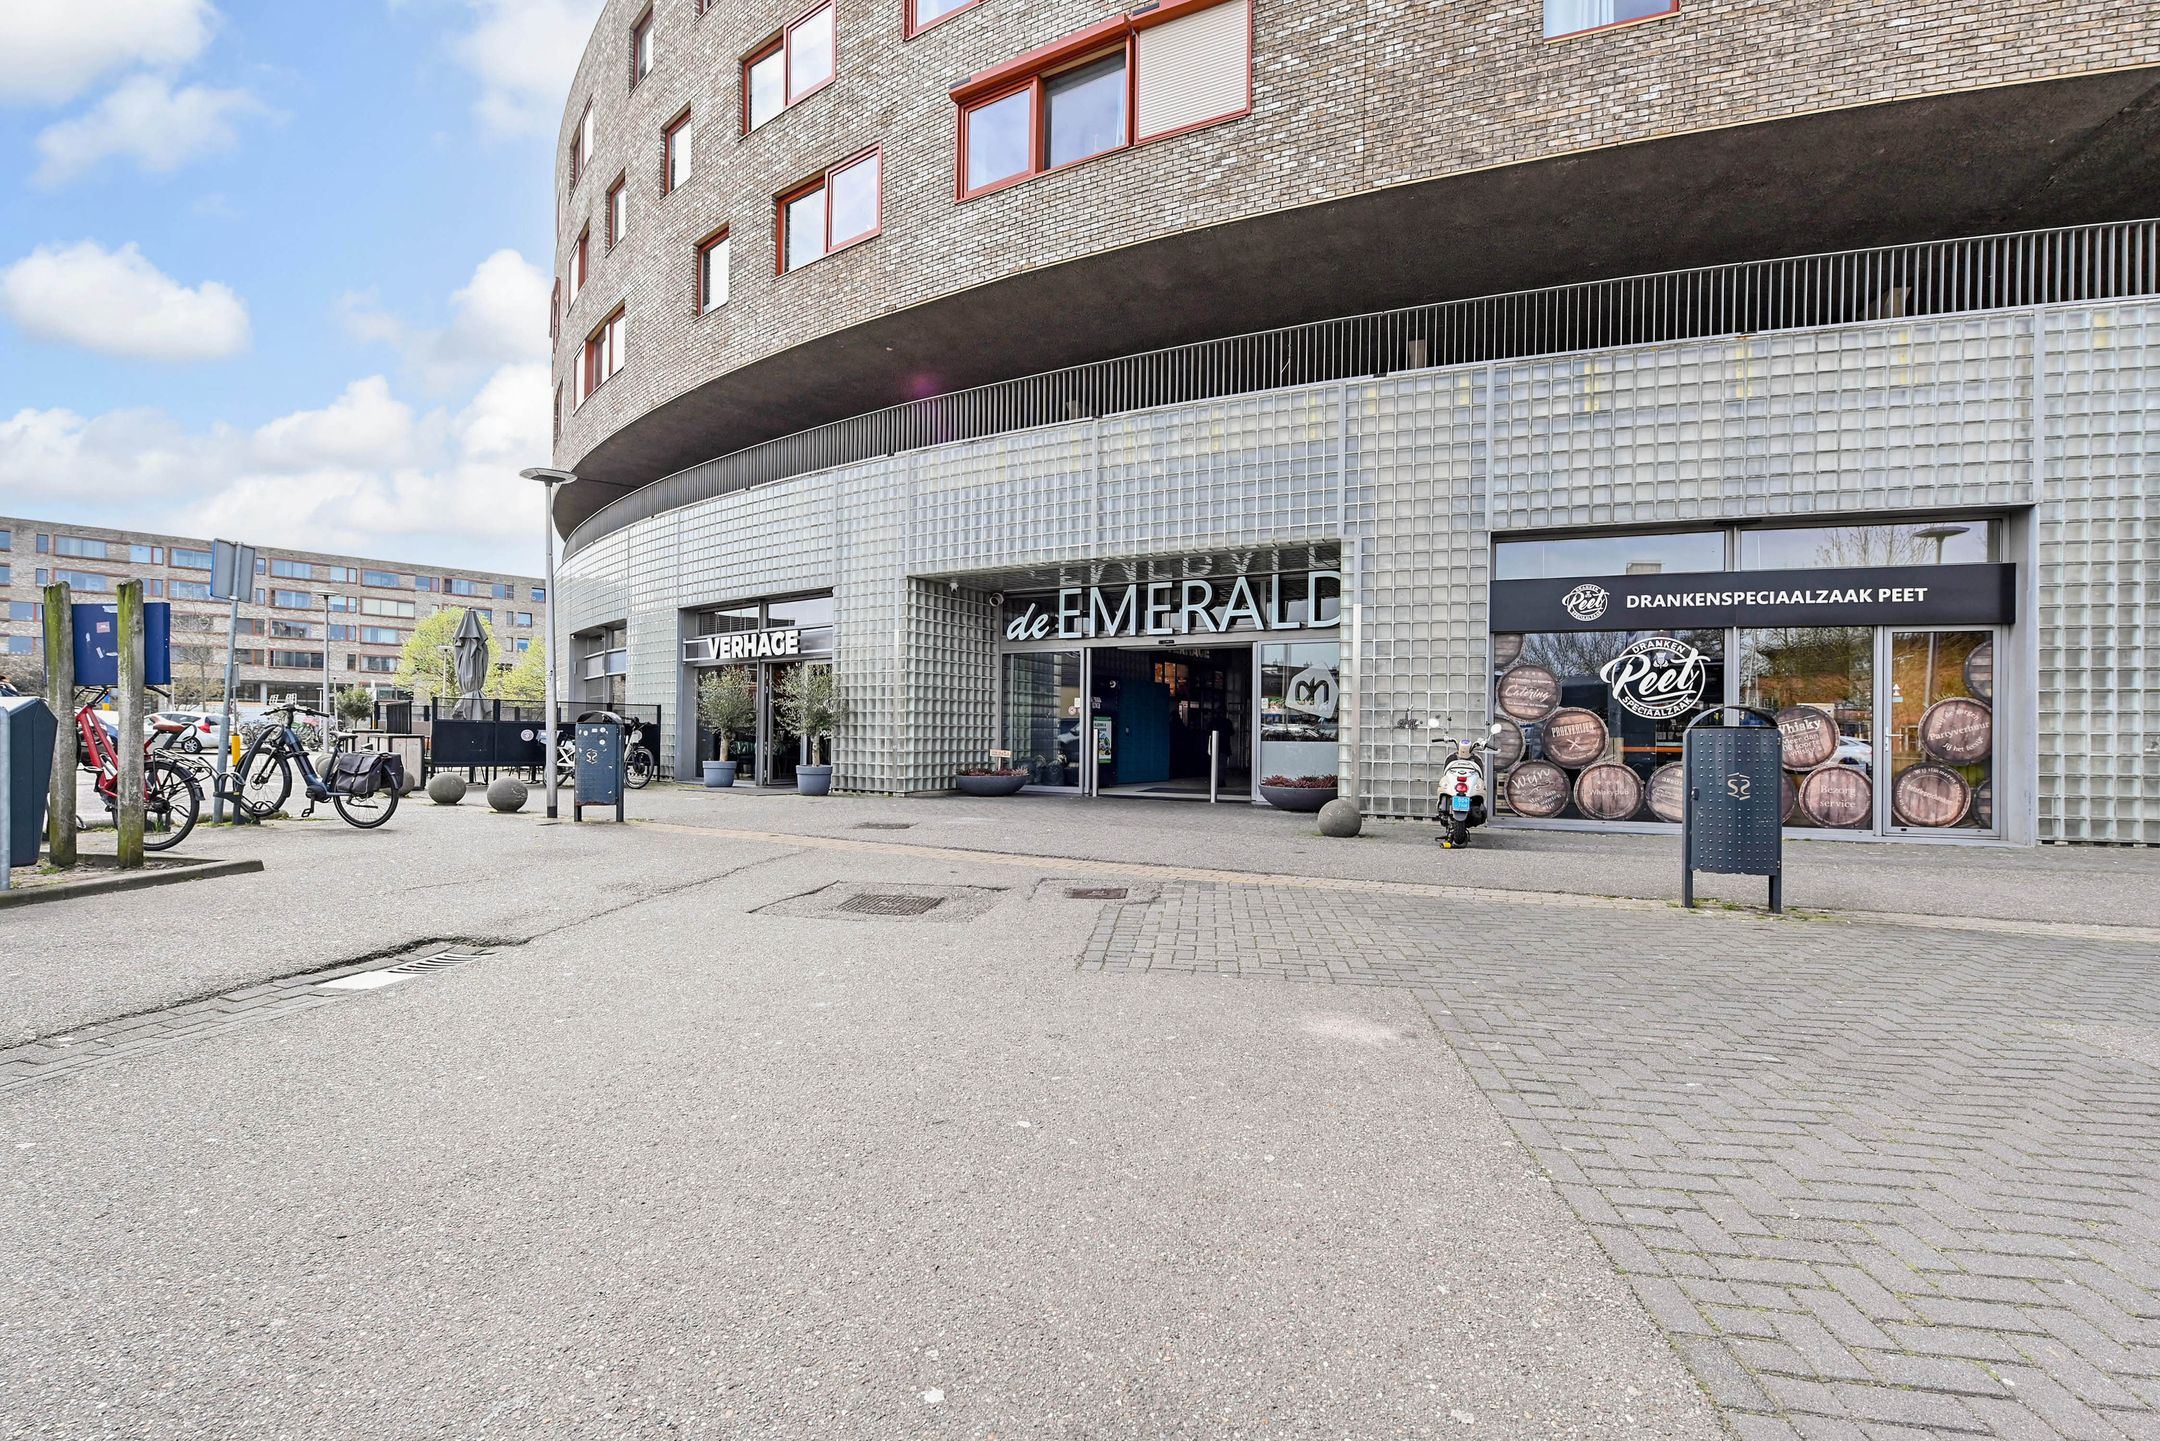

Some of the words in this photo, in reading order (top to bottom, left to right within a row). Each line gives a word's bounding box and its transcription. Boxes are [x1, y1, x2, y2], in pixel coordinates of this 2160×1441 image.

[1006, 602, 1050, 641] de
[1058, 570, 1341, 639] EMERALD
[1561, 589, 1610, 613] Peet
[1626, 588, 1873, 609] DRANKENSPECIAALZAAK
[1878, 587, 1928, 603] PEET
[707, 630, 799, 659] VERHAGE
[1632, 639, 1686, 654] DRANKEN
[1600, 648, 1711, 700] Peet
[1505, 683, 1552, 702] Catering
[1622, 696, 1693, 717] SPECIAALZAAK
[1929, 721, 1990, 741] Partyverhuur
[1512, 769, 1550, 790] Wijn
[1820, 785, 1856, 798] Bezorg
[1819, 799, 1856, 808] service
